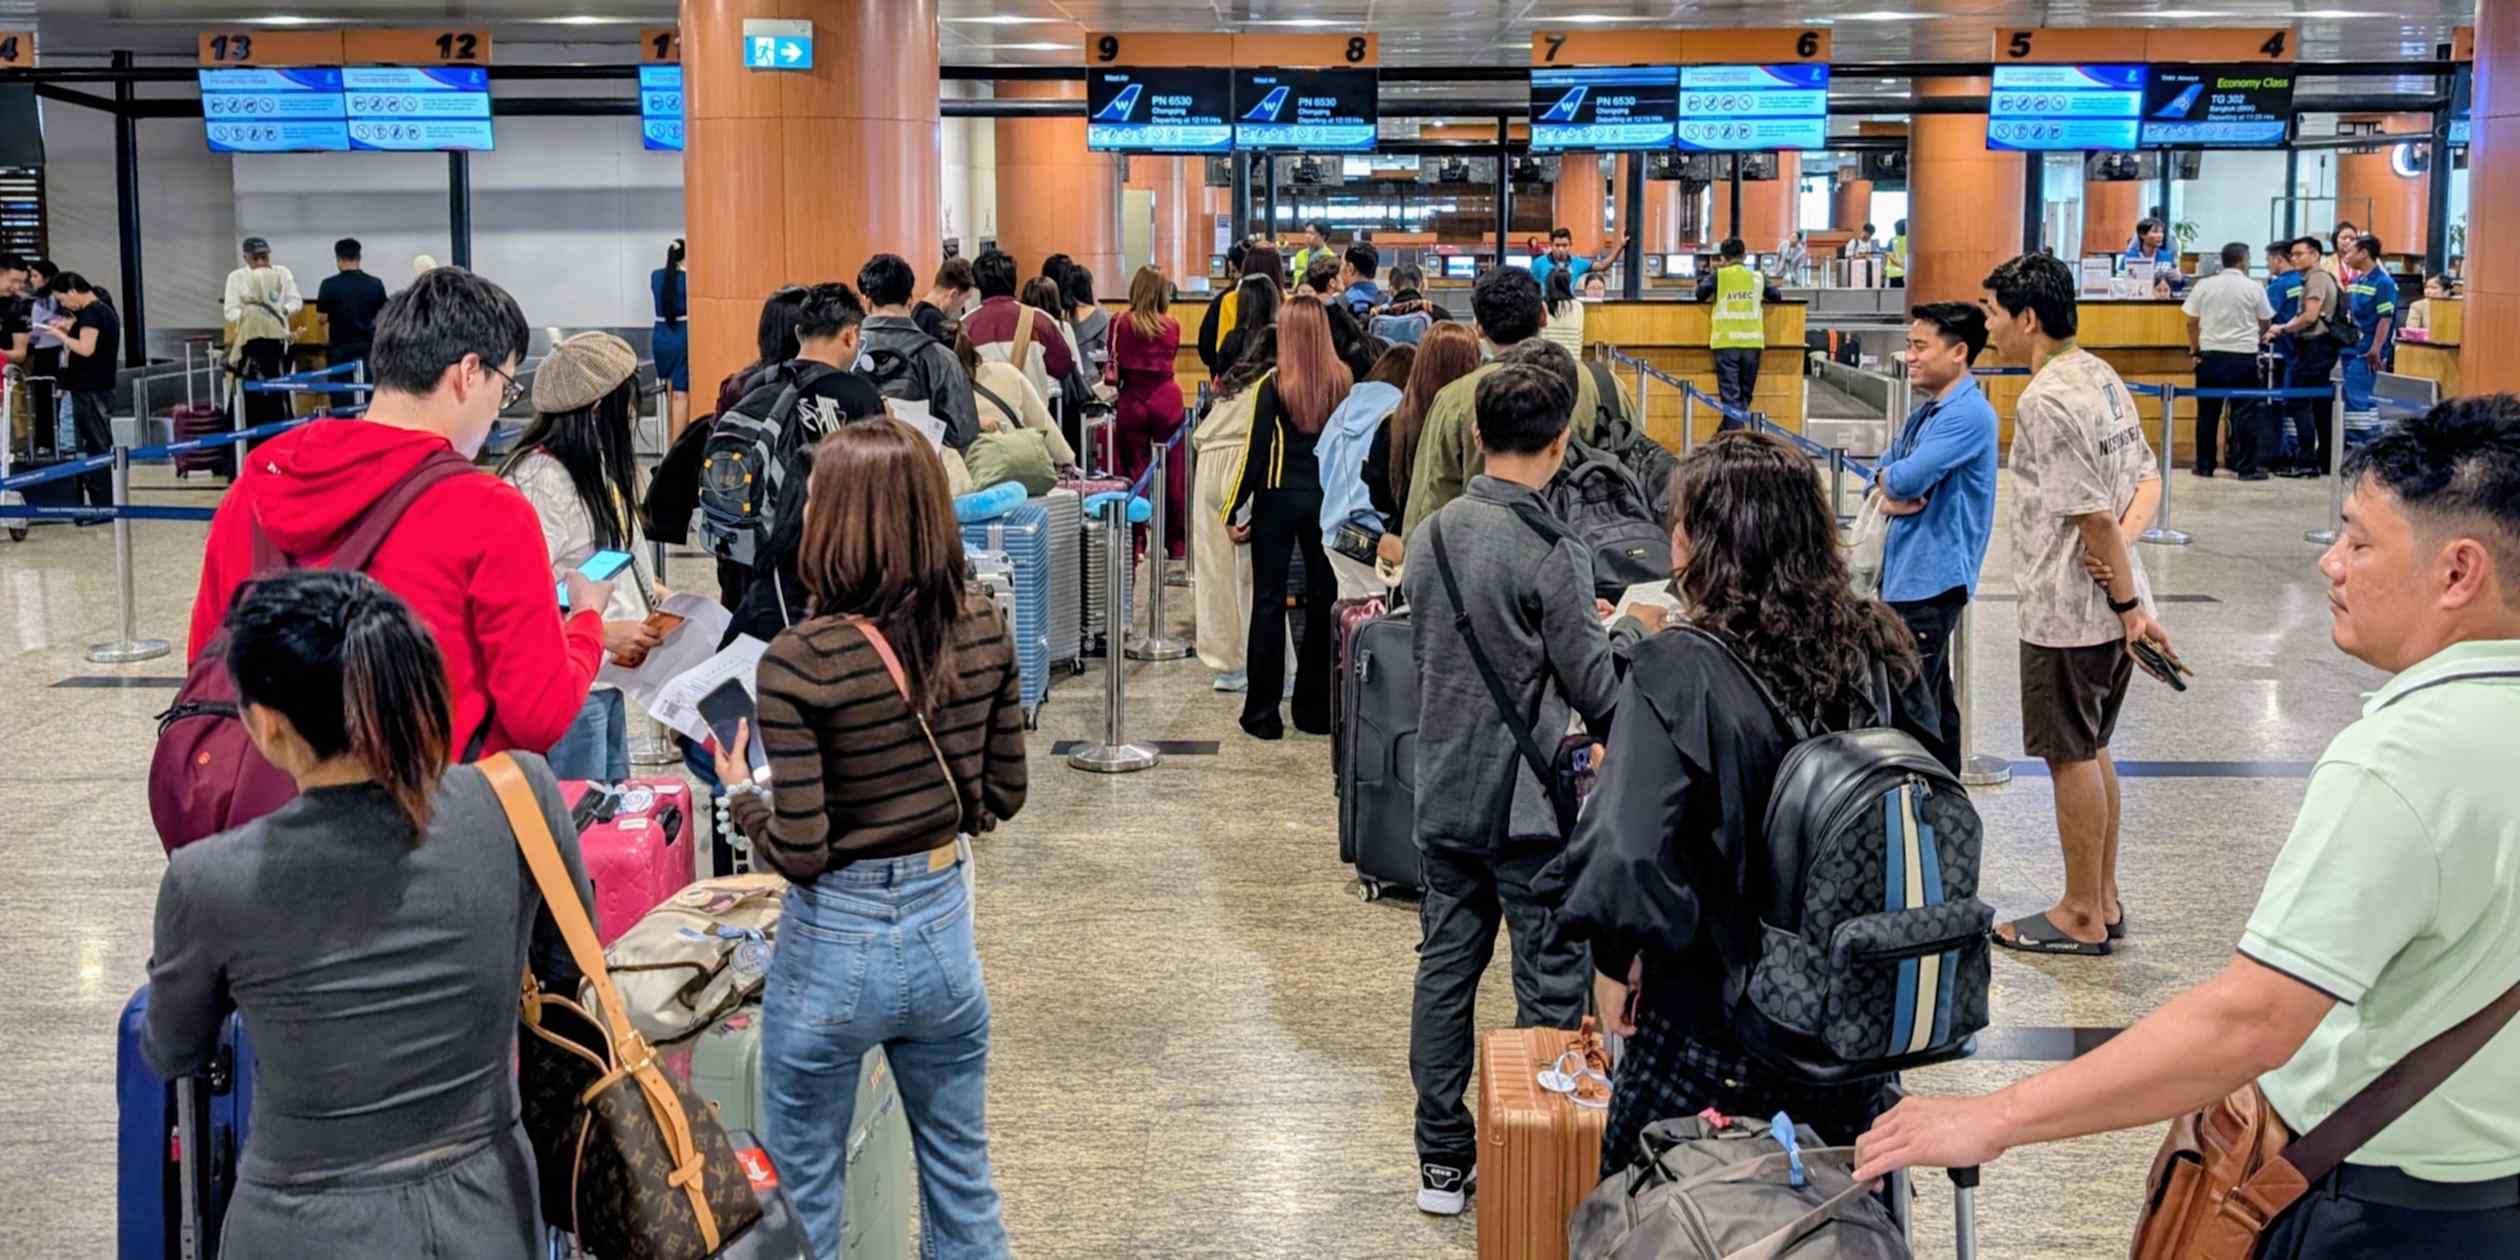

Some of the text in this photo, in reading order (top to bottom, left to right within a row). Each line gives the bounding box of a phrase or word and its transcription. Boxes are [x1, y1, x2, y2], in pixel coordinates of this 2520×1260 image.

[210, 34, 251, 61] 13
[435, 33, 477, 59] 12
[1098, 36, 1118, 61] 9
[1346, 37, 1366, 62] 8
[1544, 35, 1567, 61] 7
[1797, 32, 1819, 57] 6
[2009, 32, 2032, 57] 5
[2260, 31, 2286, 58] 4
[2217, 77, 2289, 90] Economy Class
[1151, 95, 1192, 106] PN 6530
[1298, 97, 1337, 107] PN 6530
[1596, 96, 1636, 106] PN 6530
[2211, 94, 2245, 104] TG 302
[1151, 107, 1186, 115] Chongqing
[2209, 105, 2237, 113] Bangkok
[1151, 116, 1182, 124] Departing
[1297, 117, 1327, 125] Departing
[1595, 115, 1625, 123] Departing
[2208, 114, 2237, 122] Departing
